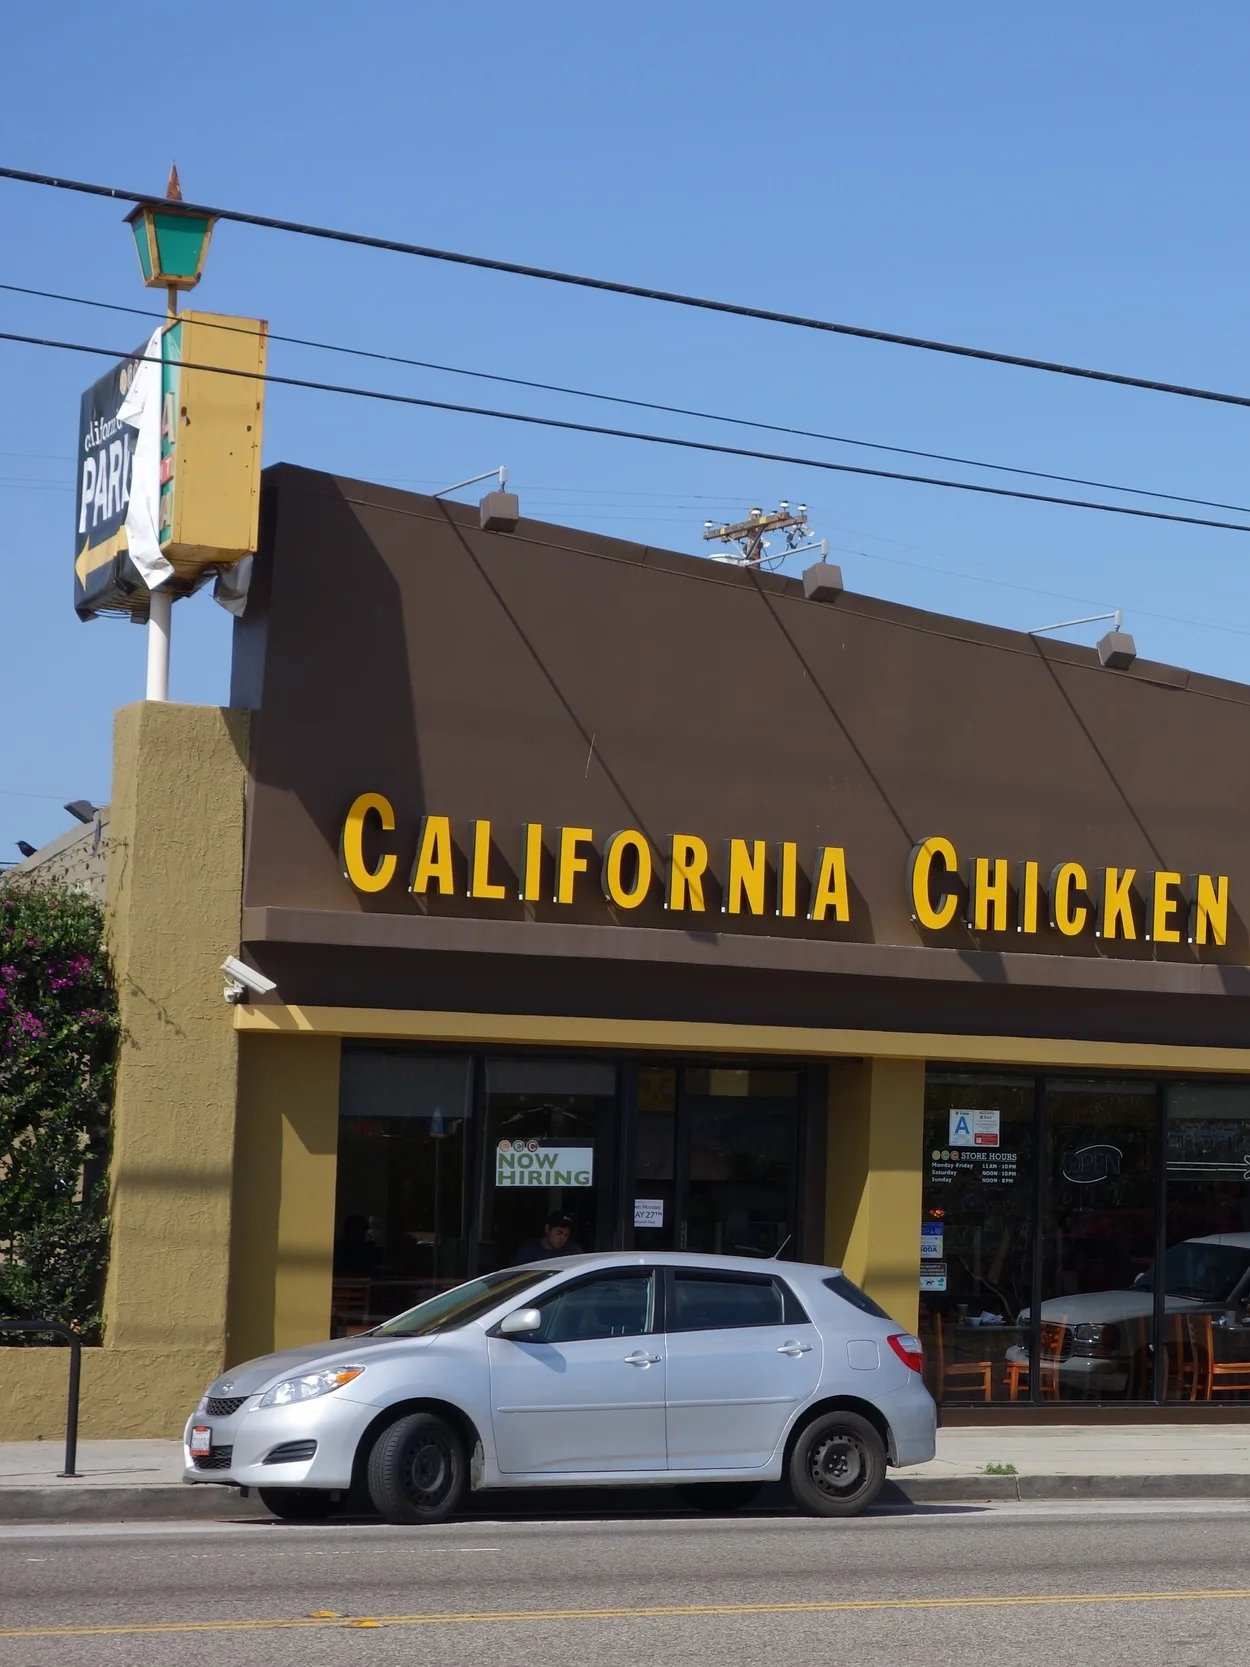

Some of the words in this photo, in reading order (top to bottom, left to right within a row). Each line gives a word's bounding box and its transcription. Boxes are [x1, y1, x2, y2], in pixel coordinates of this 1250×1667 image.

[340, 792, 851, 922] CALIFORNIA
[908, 836, 1228, 946] CHICKEN
[954, 1115, 970, 1135] A
[498, 1153, 559, 1170] NOW
[961, 1151, 987, 1160] STORE
[989, 1152, 1017, 1161] HOURS
[497, 1170, 590, 1185] HIRING
[931, 1169, 957, 1177] Saturday
[931, 1176, 953, 1184] Sunday
